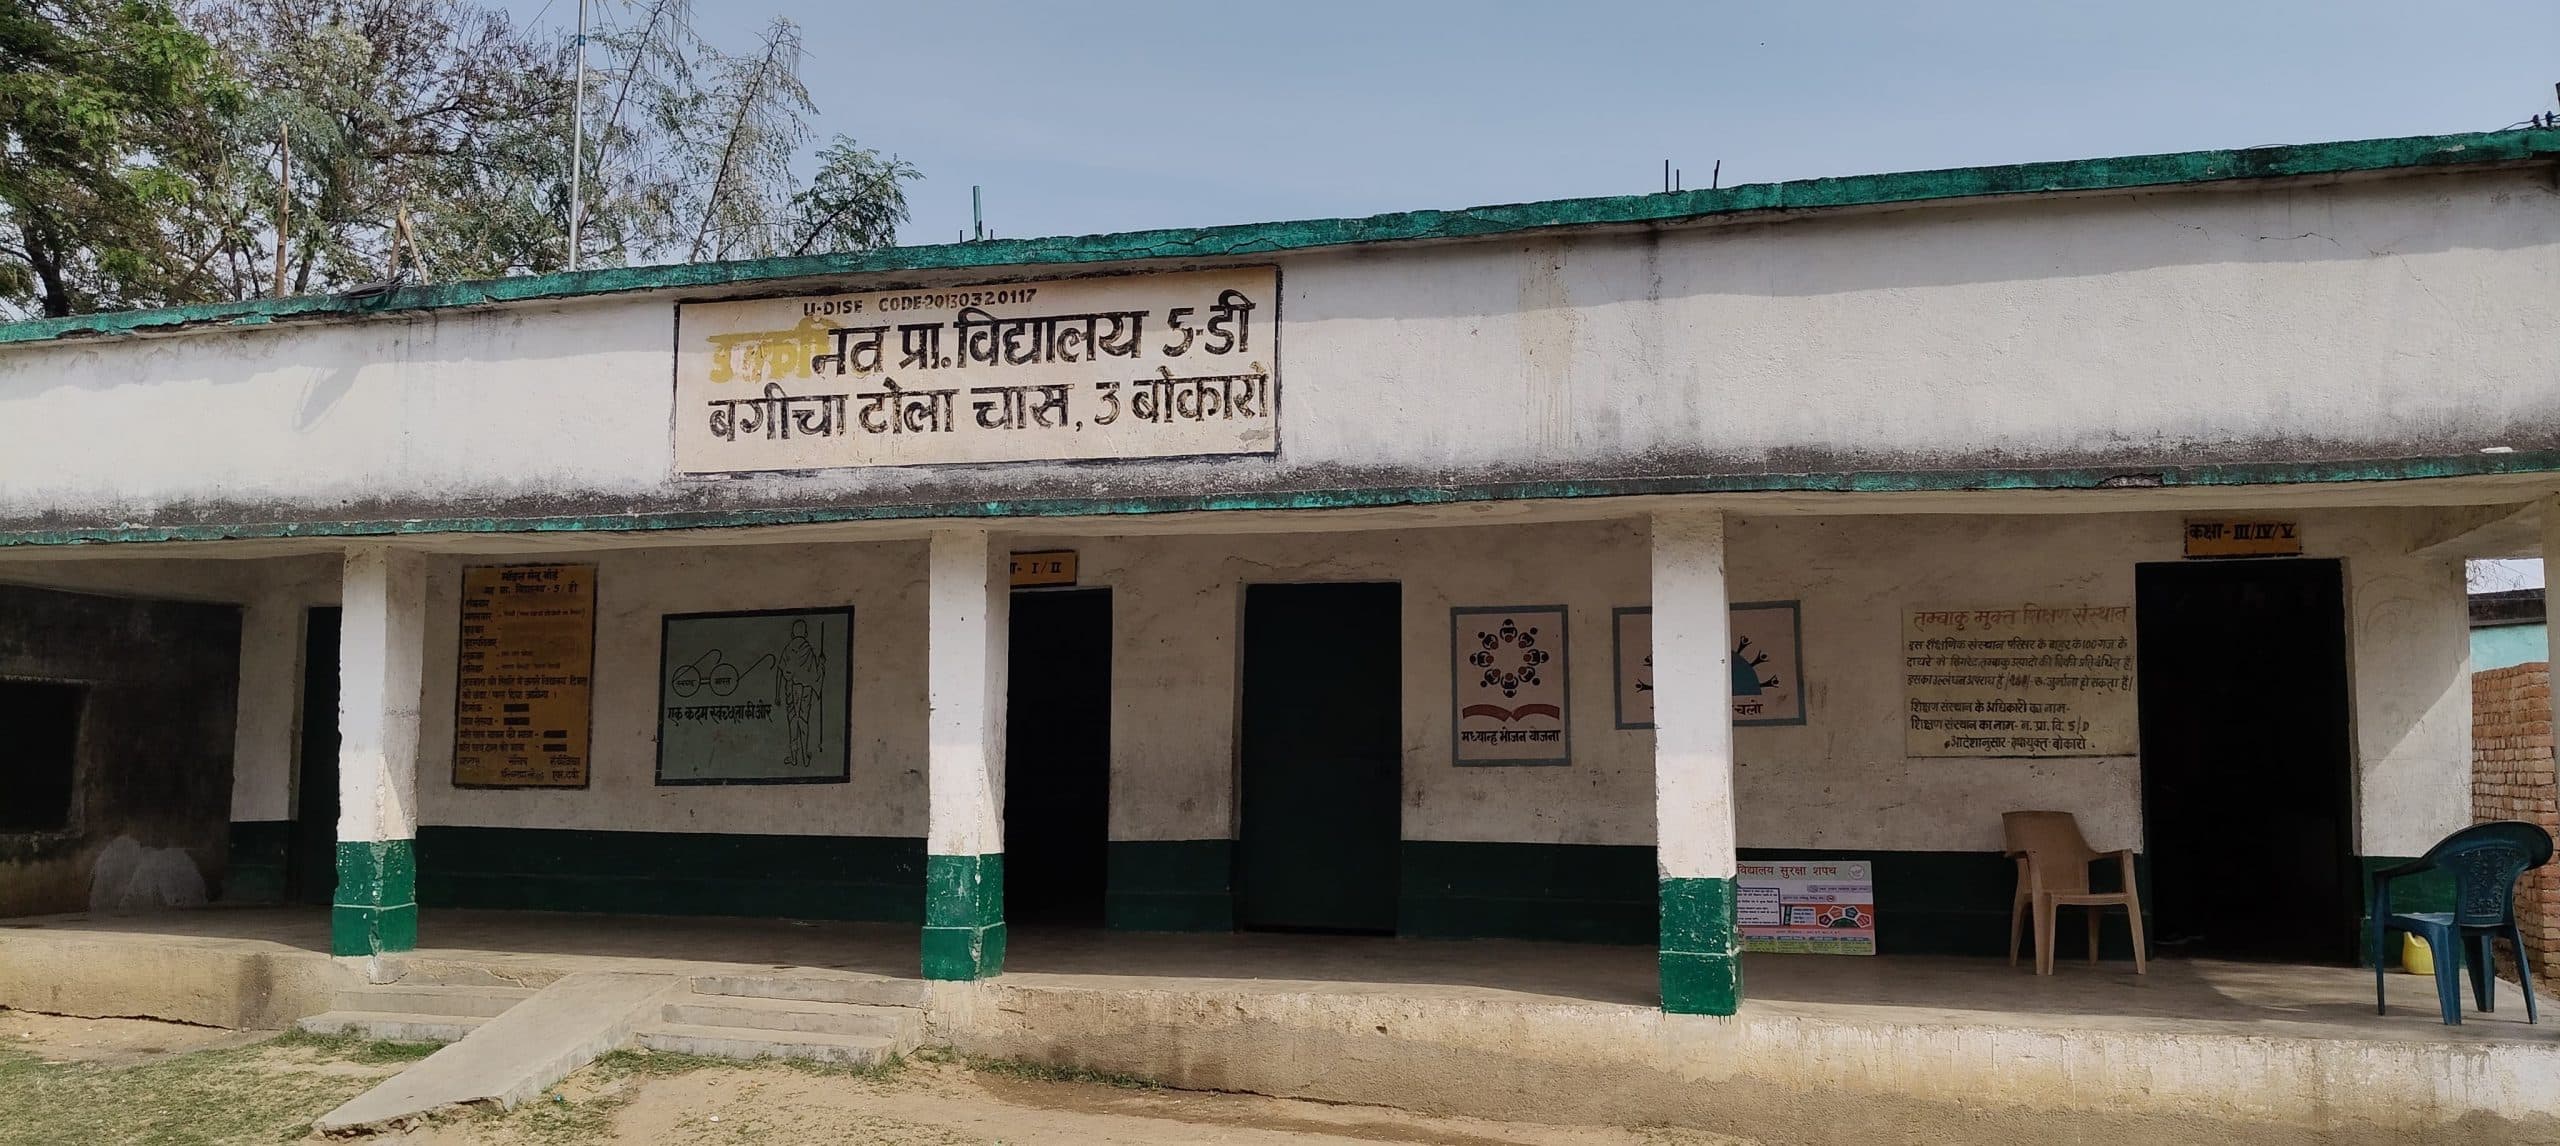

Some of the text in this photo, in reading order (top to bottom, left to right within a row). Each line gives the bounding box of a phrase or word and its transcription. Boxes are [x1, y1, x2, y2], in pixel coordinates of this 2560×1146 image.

[953, 307, 1149, 366] विद्यालय
[707, 382, 849, 442] बगीचा
[857, 376, 959, 435] टोला
[1132, 361, 1270, 425] बोकारो
[1779, 864, 1807, 878] सुरक्षा
